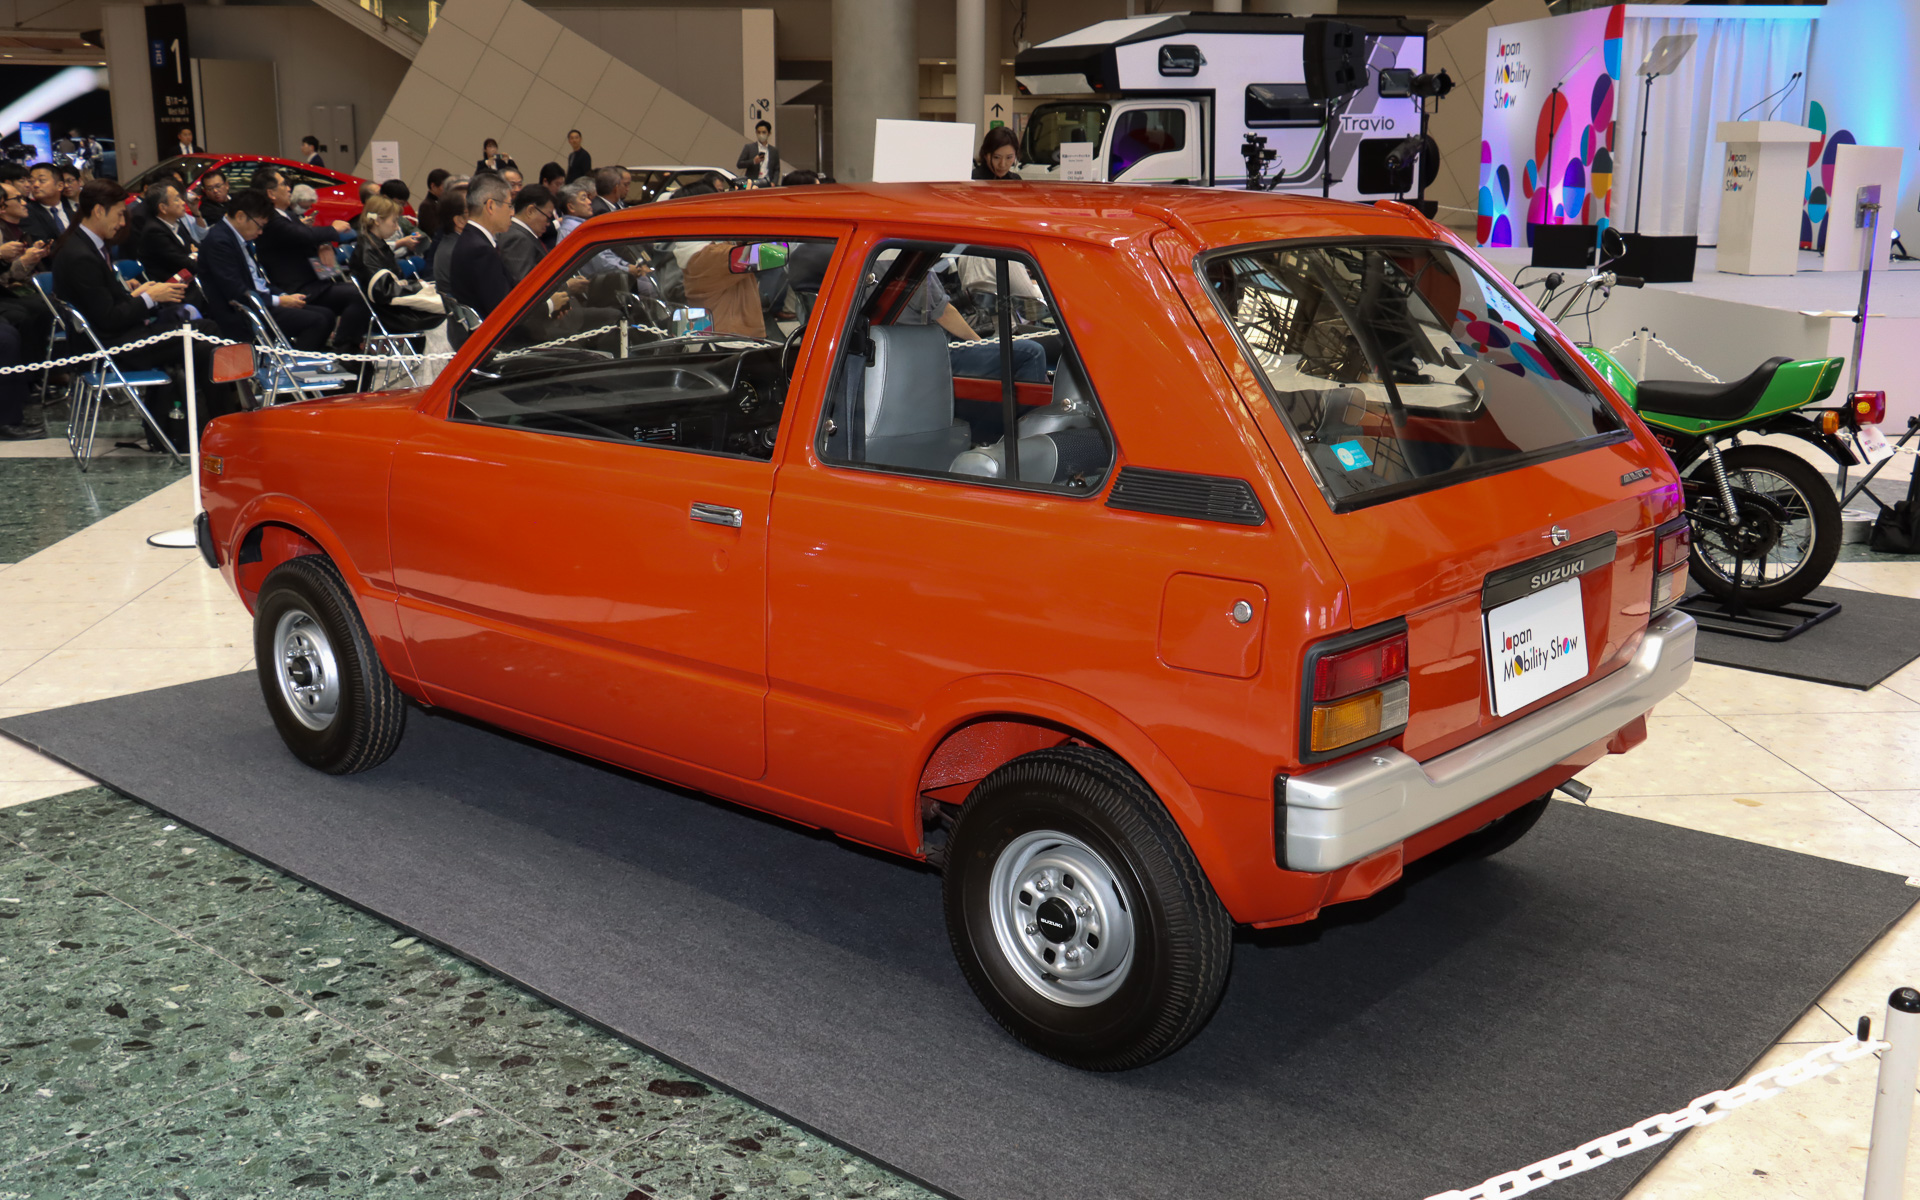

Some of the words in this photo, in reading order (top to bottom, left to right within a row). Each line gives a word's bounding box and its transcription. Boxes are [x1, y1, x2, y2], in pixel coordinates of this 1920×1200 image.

[1496, 37, 1521, 63] Japan
[170, 38, 182, 84] 1
[1494, 61, 1531, 89] Mobility
[1493, 88, 1517, 109] Show
[1341, 116, 1395, 132] Travio
[1728, 150, 1746, 165] Japan
[1726, 165, 1754, 182] Mobility
[1725, 179, 1743, 192] Show
[1622, 467, 1652, 484] ALTO
[1531, 559, 1585, 589] SUZUKI
[1501, 628, 1532, 655] Japan
[1503, 646, 1549, 682] Mobility
[1550, 635, 1578, 660] Show
[1040, 917, 1063, 929] SUZUKI
